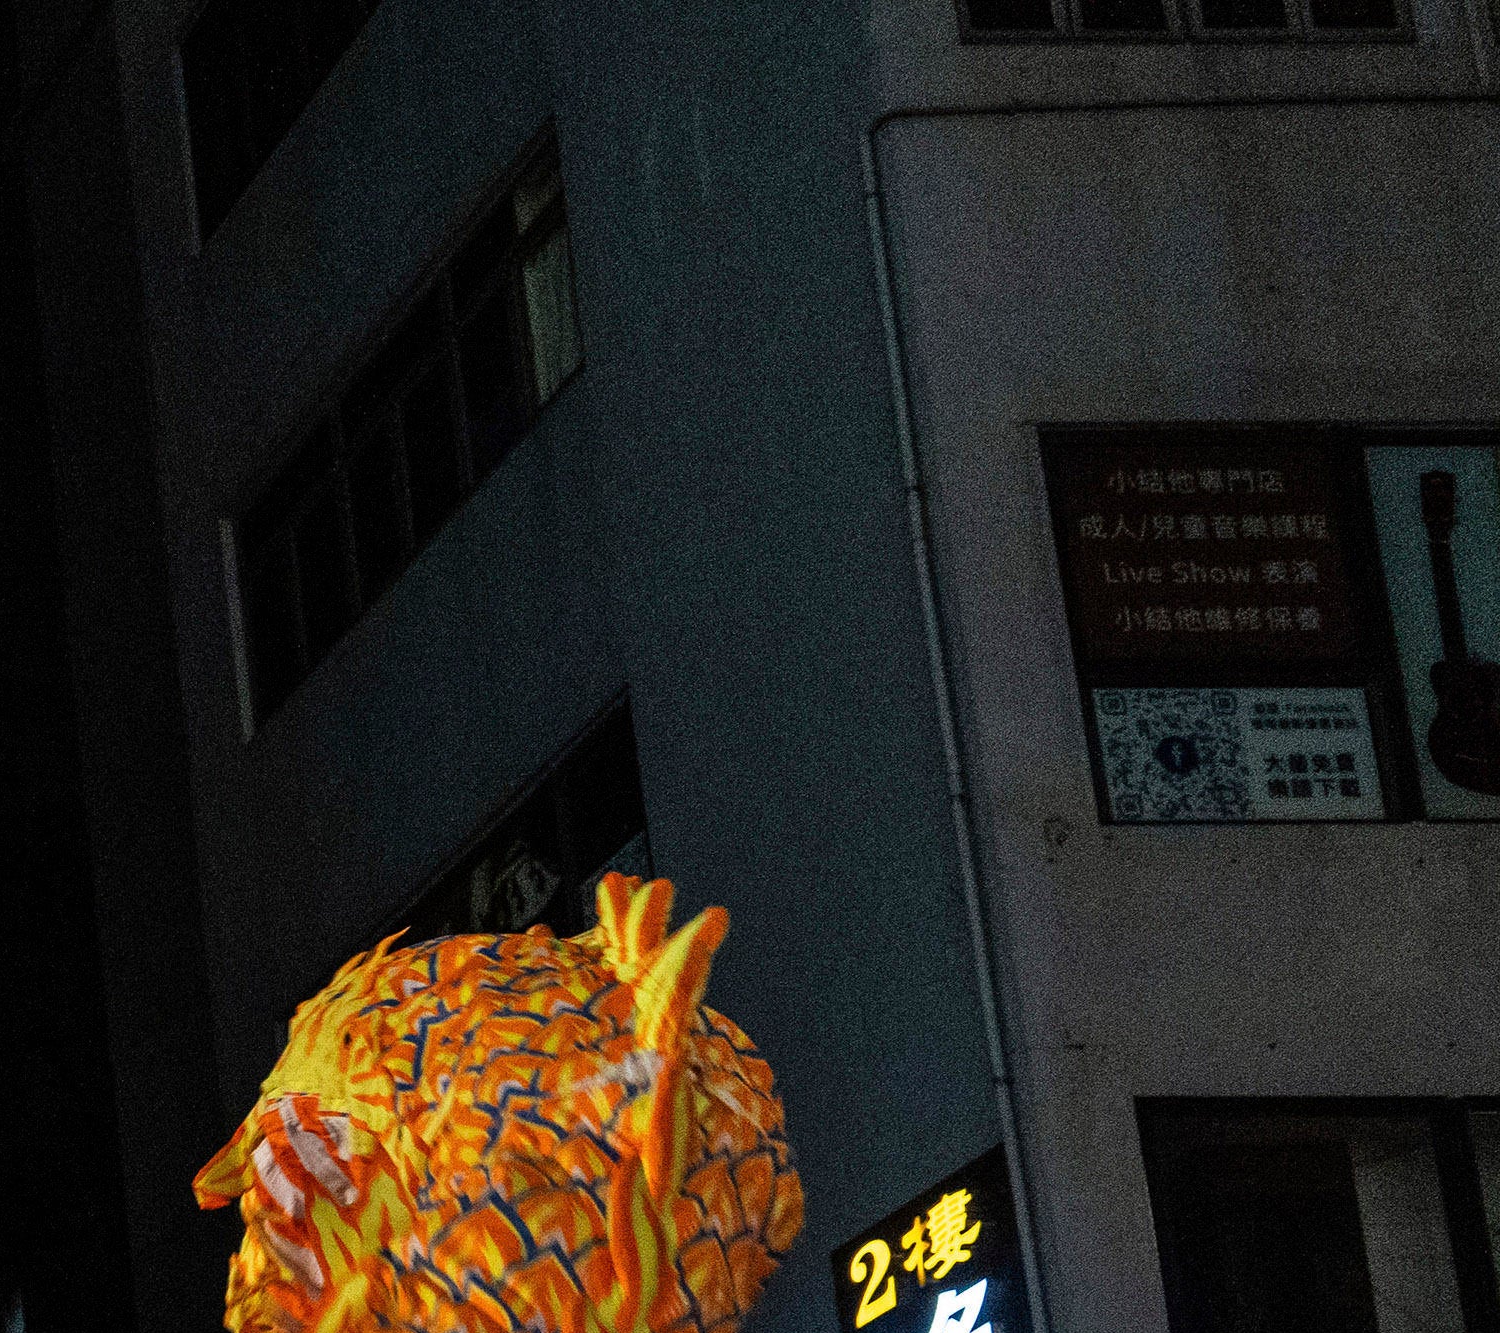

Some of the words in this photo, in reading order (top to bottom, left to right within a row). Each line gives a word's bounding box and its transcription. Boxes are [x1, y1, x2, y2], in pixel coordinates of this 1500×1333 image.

[1104, 560, 1162, 586] Live
[1171, 560, 1252, 586] Show
[850, 1187, 982, 1329] 2樓
